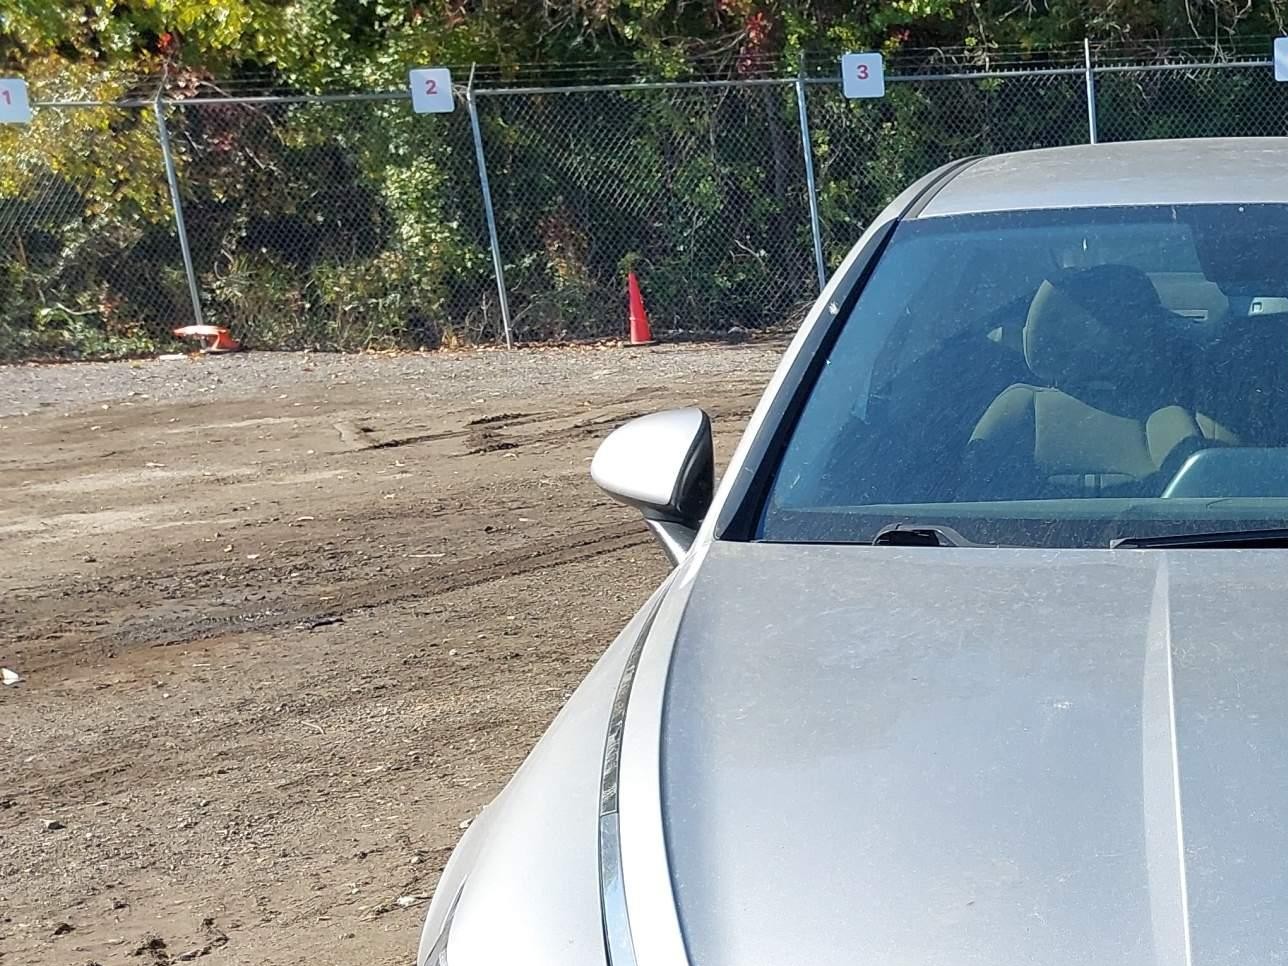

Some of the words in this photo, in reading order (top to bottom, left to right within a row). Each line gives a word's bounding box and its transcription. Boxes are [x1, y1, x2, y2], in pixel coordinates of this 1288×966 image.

[857, 64, 869, 80] 3
[425, 79, 438, 95] 2
[2, 90, 11, 105] 1
